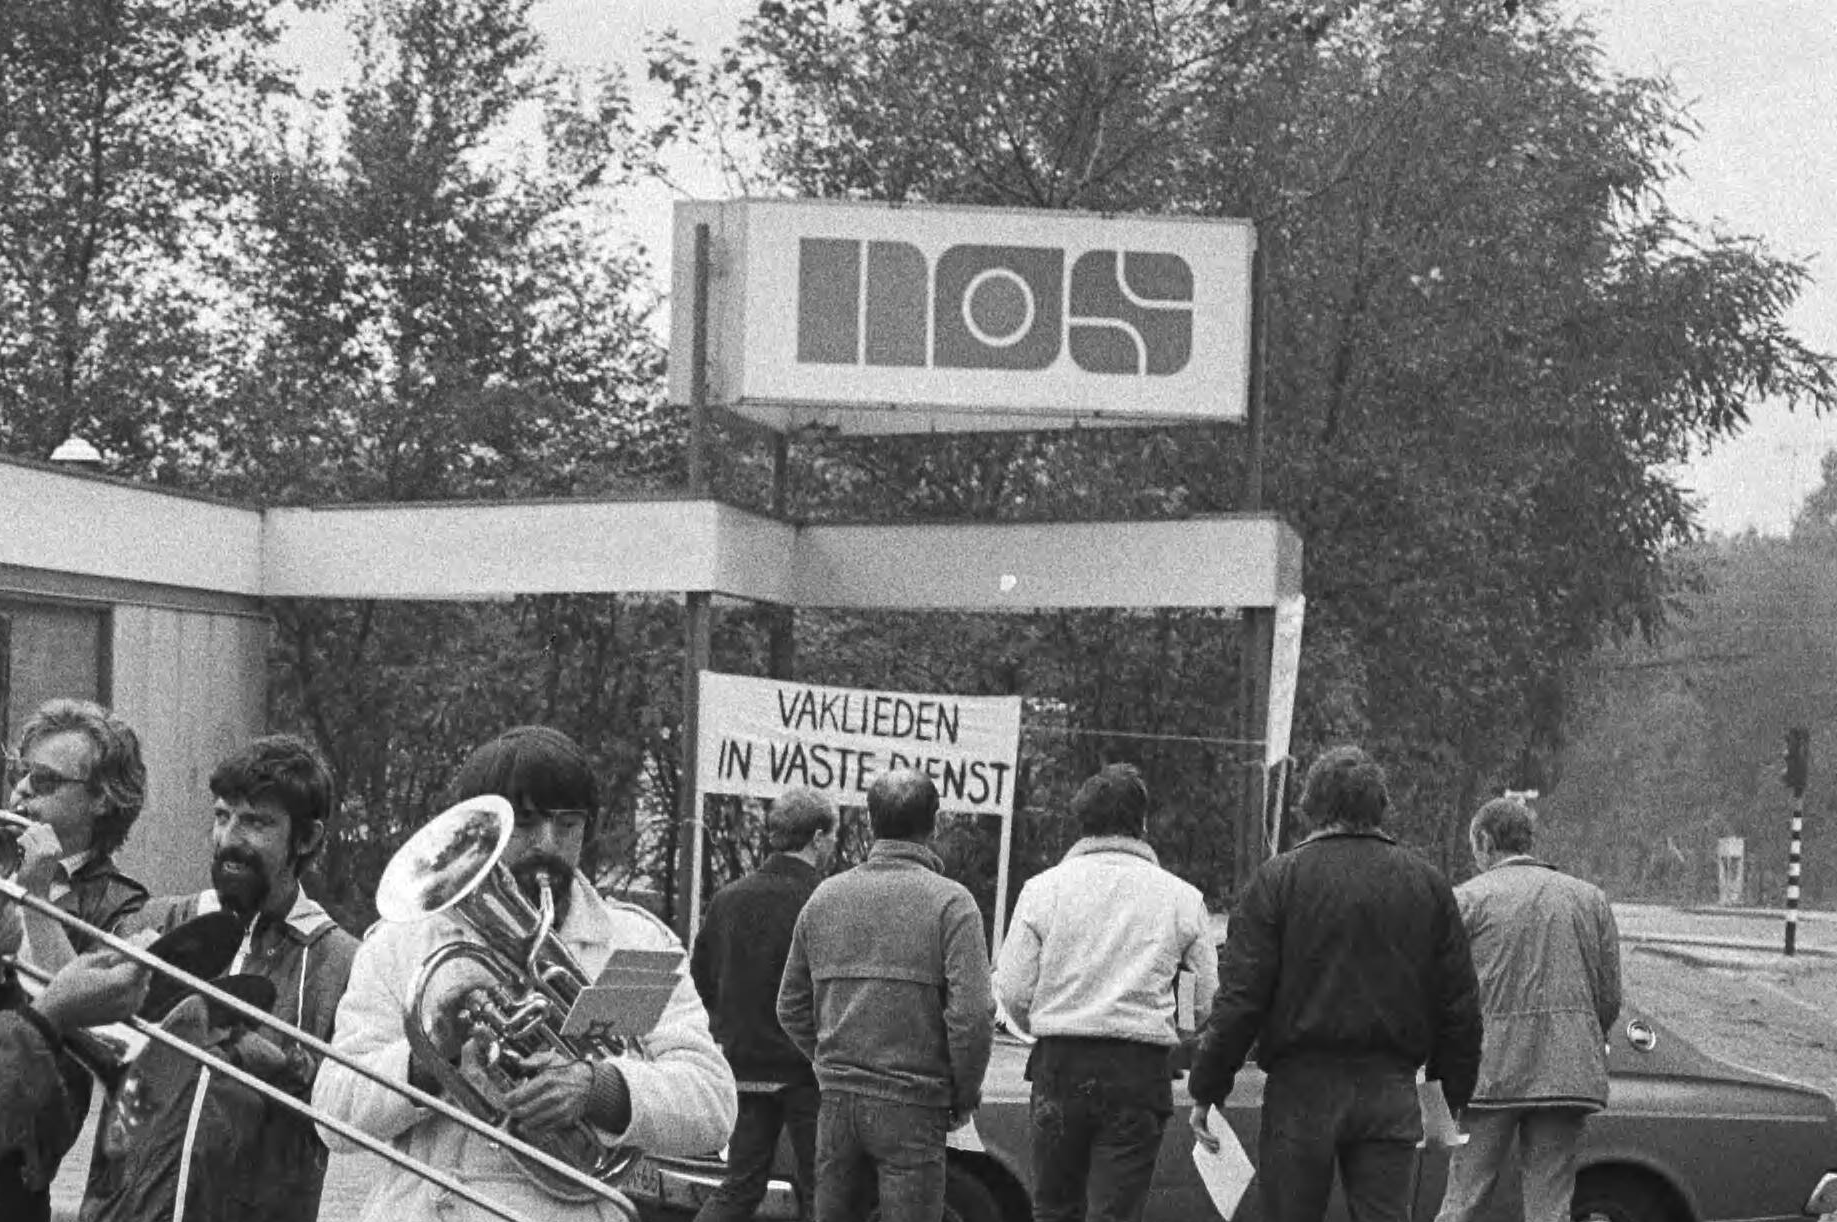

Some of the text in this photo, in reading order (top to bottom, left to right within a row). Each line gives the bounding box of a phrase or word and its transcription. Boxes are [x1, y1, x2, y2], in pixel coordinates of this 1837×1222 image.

[777, 688, 959, 745] VAKLIEDEN
[717, 739, 753, 781] IN
[769, 741, 877, 793] VASTE
